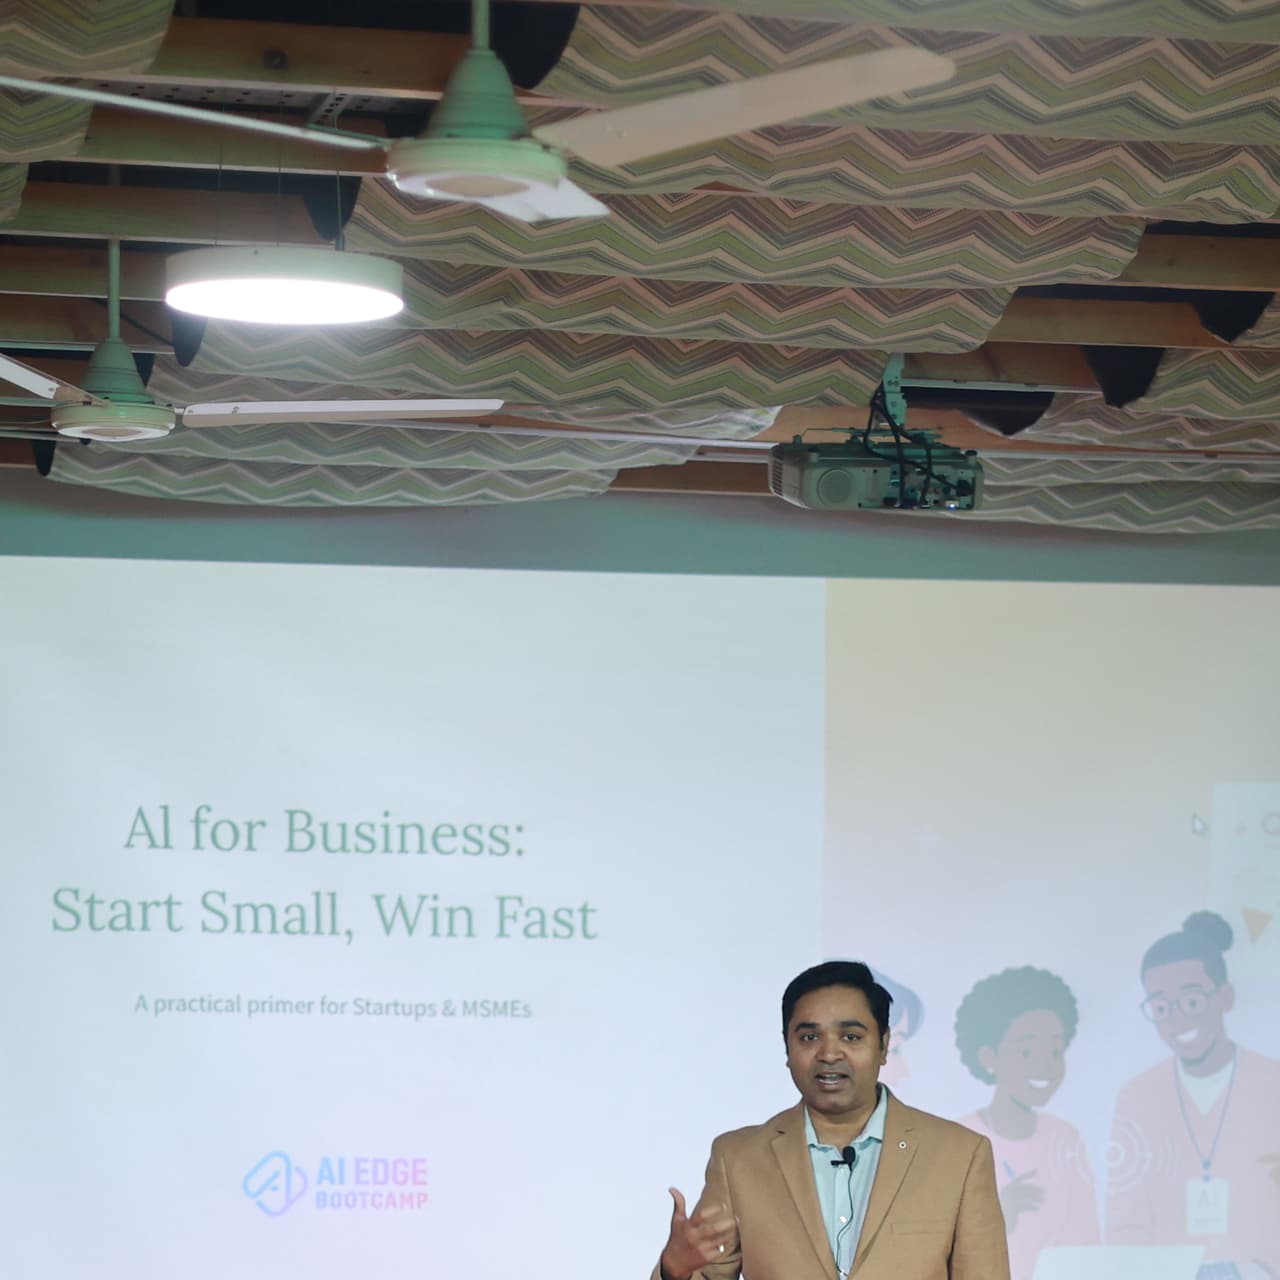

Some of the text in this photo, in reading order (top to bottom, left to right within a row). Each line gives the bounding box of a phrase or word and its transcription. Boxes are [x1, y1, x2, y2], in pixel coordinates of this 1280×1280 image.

[190, 804, 267, 852] for
[283, 808, 526, 857] Business:
[51, 887, 599, 946] Start Small, Win Fast
[134, 994, 532, 1022] A practical primer for Startups & MSMEs
[316, 1157, 429, 1187] AI EDGE
[315, 1191, 429, 1210] BOOTCAMP
